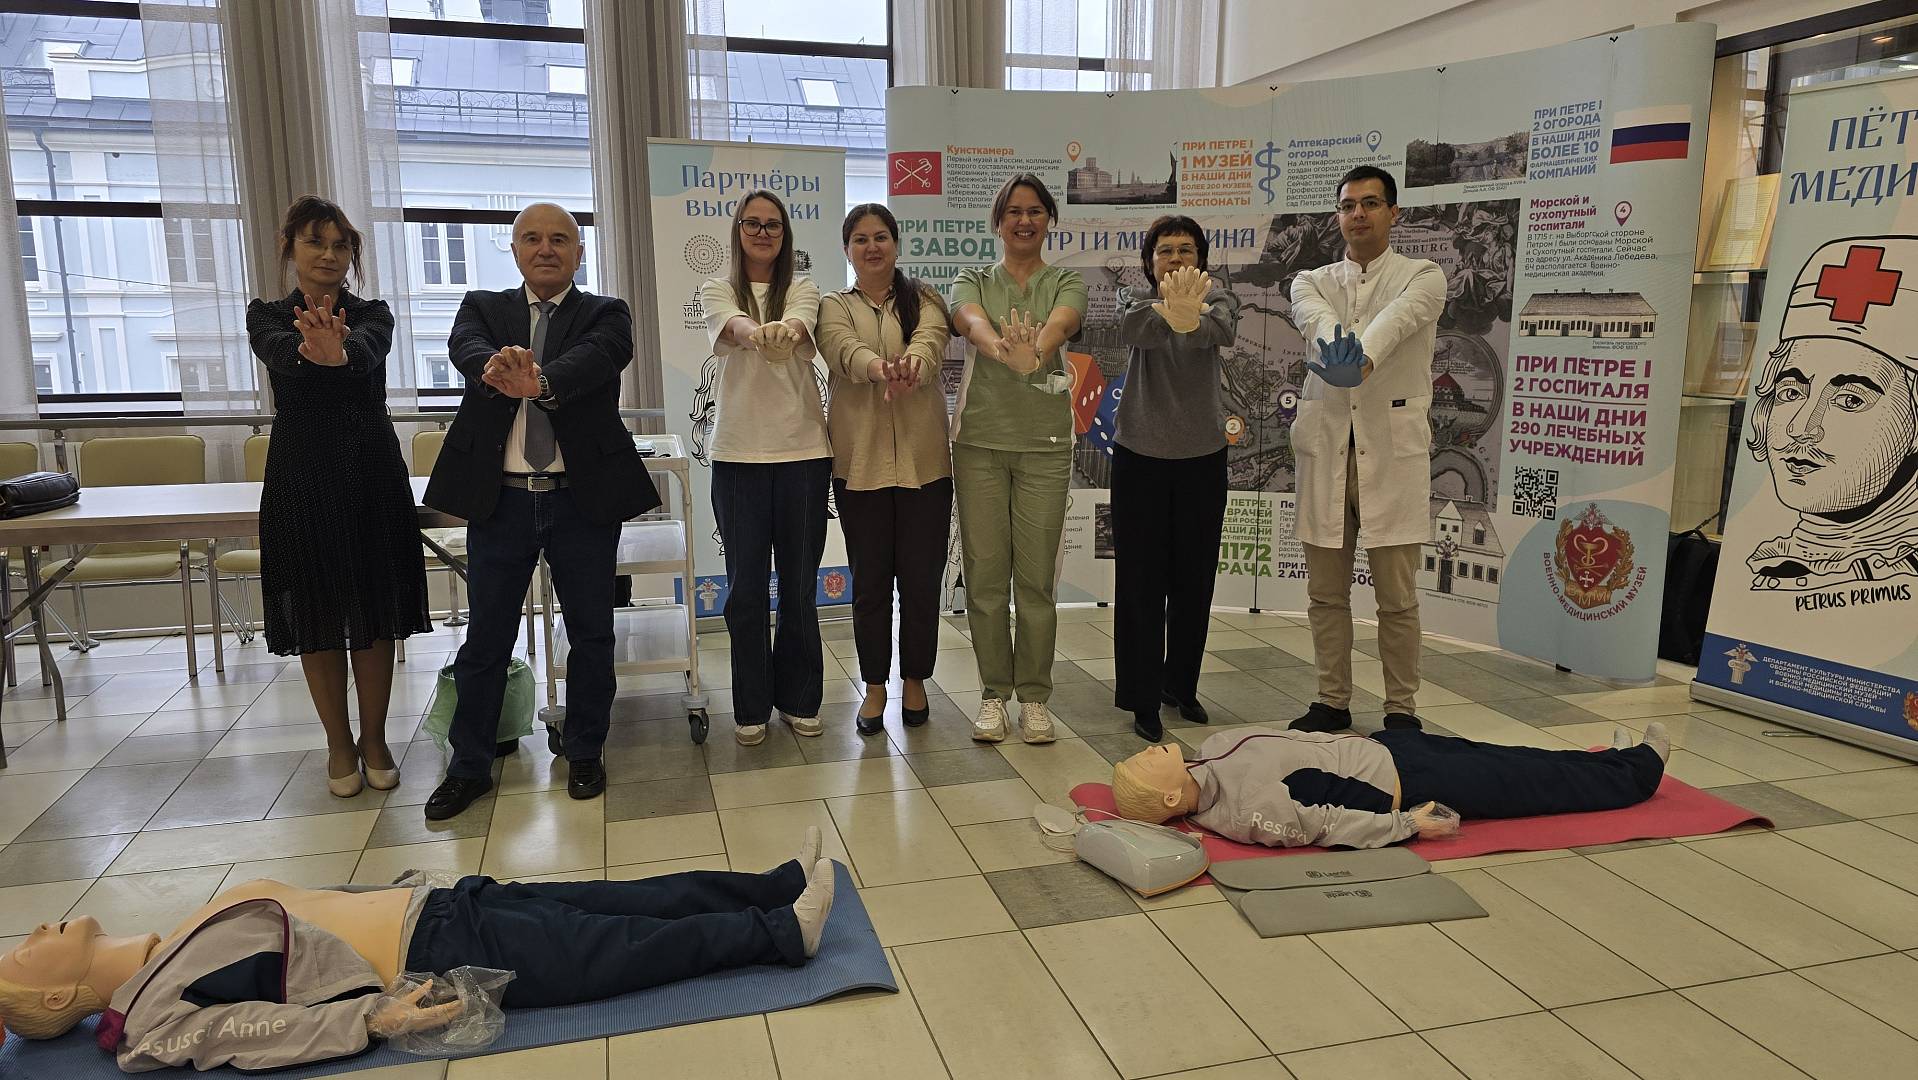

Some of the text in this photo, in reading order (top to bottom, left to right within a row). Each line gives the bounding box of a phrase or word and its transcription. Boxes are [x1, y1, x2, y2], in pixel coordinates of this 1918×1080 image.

[1534, 107, 1557, 120] ПРИ
[1559, 101, 1596, 116] ПЕТРЕ
[1533, 113, 1601, 131] 2 ОГОРОДА
[1828, 106, 1918, 152] ПЁТ
[1182, 141, 1206, 151] ПРИ
[1209, 140, 1247, 150] ПЕТРЕ
[1288, 134, 1362, 148] Аптекарский
[1532, 128, 1601, 146] В НАШИ ДНИ
[946, 145, 1014, 156] Кунсткамера
[1181, 150, 1252, 169] 1 МУЗЕЙ
[1288, 150, 1328, 159] огород
[1531, 141, 1599, 161] БОЛЕЕ 10
[1530, 155, 1598, 168] ФАРМАЦЕВТИЧЕСКИХ
[1181, 171, 1252, 182] В НАШИ ДНИ
[1529, 162, 1596, 180] КОМПАНИЙ
[682, 164, 820, 197] Партнёры
[1788, 162, 1918, 208] МЕДИ
[685, 200, 820, 220] выски
[1181, 197, 1251, 207] ЭКСПОНАТЫ
[1530, 194, 1590, 209] Морской и
[1529, 205, 1597, 221] сухопутный
[933, 220, 986, 234] ПЕТРЕ
[1528, 221, 1585, 232] госпитали
[1534, 233, 1548, 241] 1715
[1567, 230, 1609, 239] Выборгской
[1611, 229, 1645, 237] стороне
[910, 237, 997, 261] ЗАВОД
[1095, 231, 1109, 251] И
[1614, 236, 1654, 245] Морской
[1532, 247, 1575, 256] Сухопутный
[1574, 253, 1612, 261] Академика
[1614, 252, 1658, 261] Лебедева,
[908, 266, 958, 279] НАШИ
[1524, 270, 1570, 278] медицинская
[1515, 355, 1558, 374] ПРИ
[1563, 357, 1637, 378] ПЕТРЕ
[1513, 377, 1650, 399] 2 ГОСПИТАЛЯ
[1512, 401, 1647, 428] В НАШИ ДНИ
[1510, 421, 1647, 446] 290 ЛЕЧЕБНЫХ
[1509, 438, 1644, 466] УЧРЕЖДЕНИЙ
[1231, 498, 1267, 508] ПЕТРЕ
[1227, 507, 1273, 518] ВРАЧЕЙ
[1222, 526, 1272, 536] АШИ ДНИ
[1218, 561, 1272, 578] РАЧА
[1278, 561, 1298, 570] ПРИ
[1278, 569, 1285, 578] 2
[1795, 584, 1912, 612] PETRUS PRIMUS
[1762, 656, 1901, 694] ДЕПАРТАМЕНТ КУЛЬТУРЫ МИНИСТЕРСТВА
[1769, 663, 1892, 698] ОБОРОНЫ РОССИЙСКОЙ ФЕДЕРАЦИИ
[1774, 670, 1878, 700] ВОЕННО-МЕДИЦИНСКИЙ МУЗЕЙ
[1782, 677, 1872, 703] МУЗЕЙ МЕДИЦИНЫ РОССИИ
[1775, 680, 1853, 704] ВОЕННО-МЕДИЦИНСКОЙ
[1854, 700, 1887, 714] СЛУЖБЫ
[217, 1015, 288, 1039] Anne
